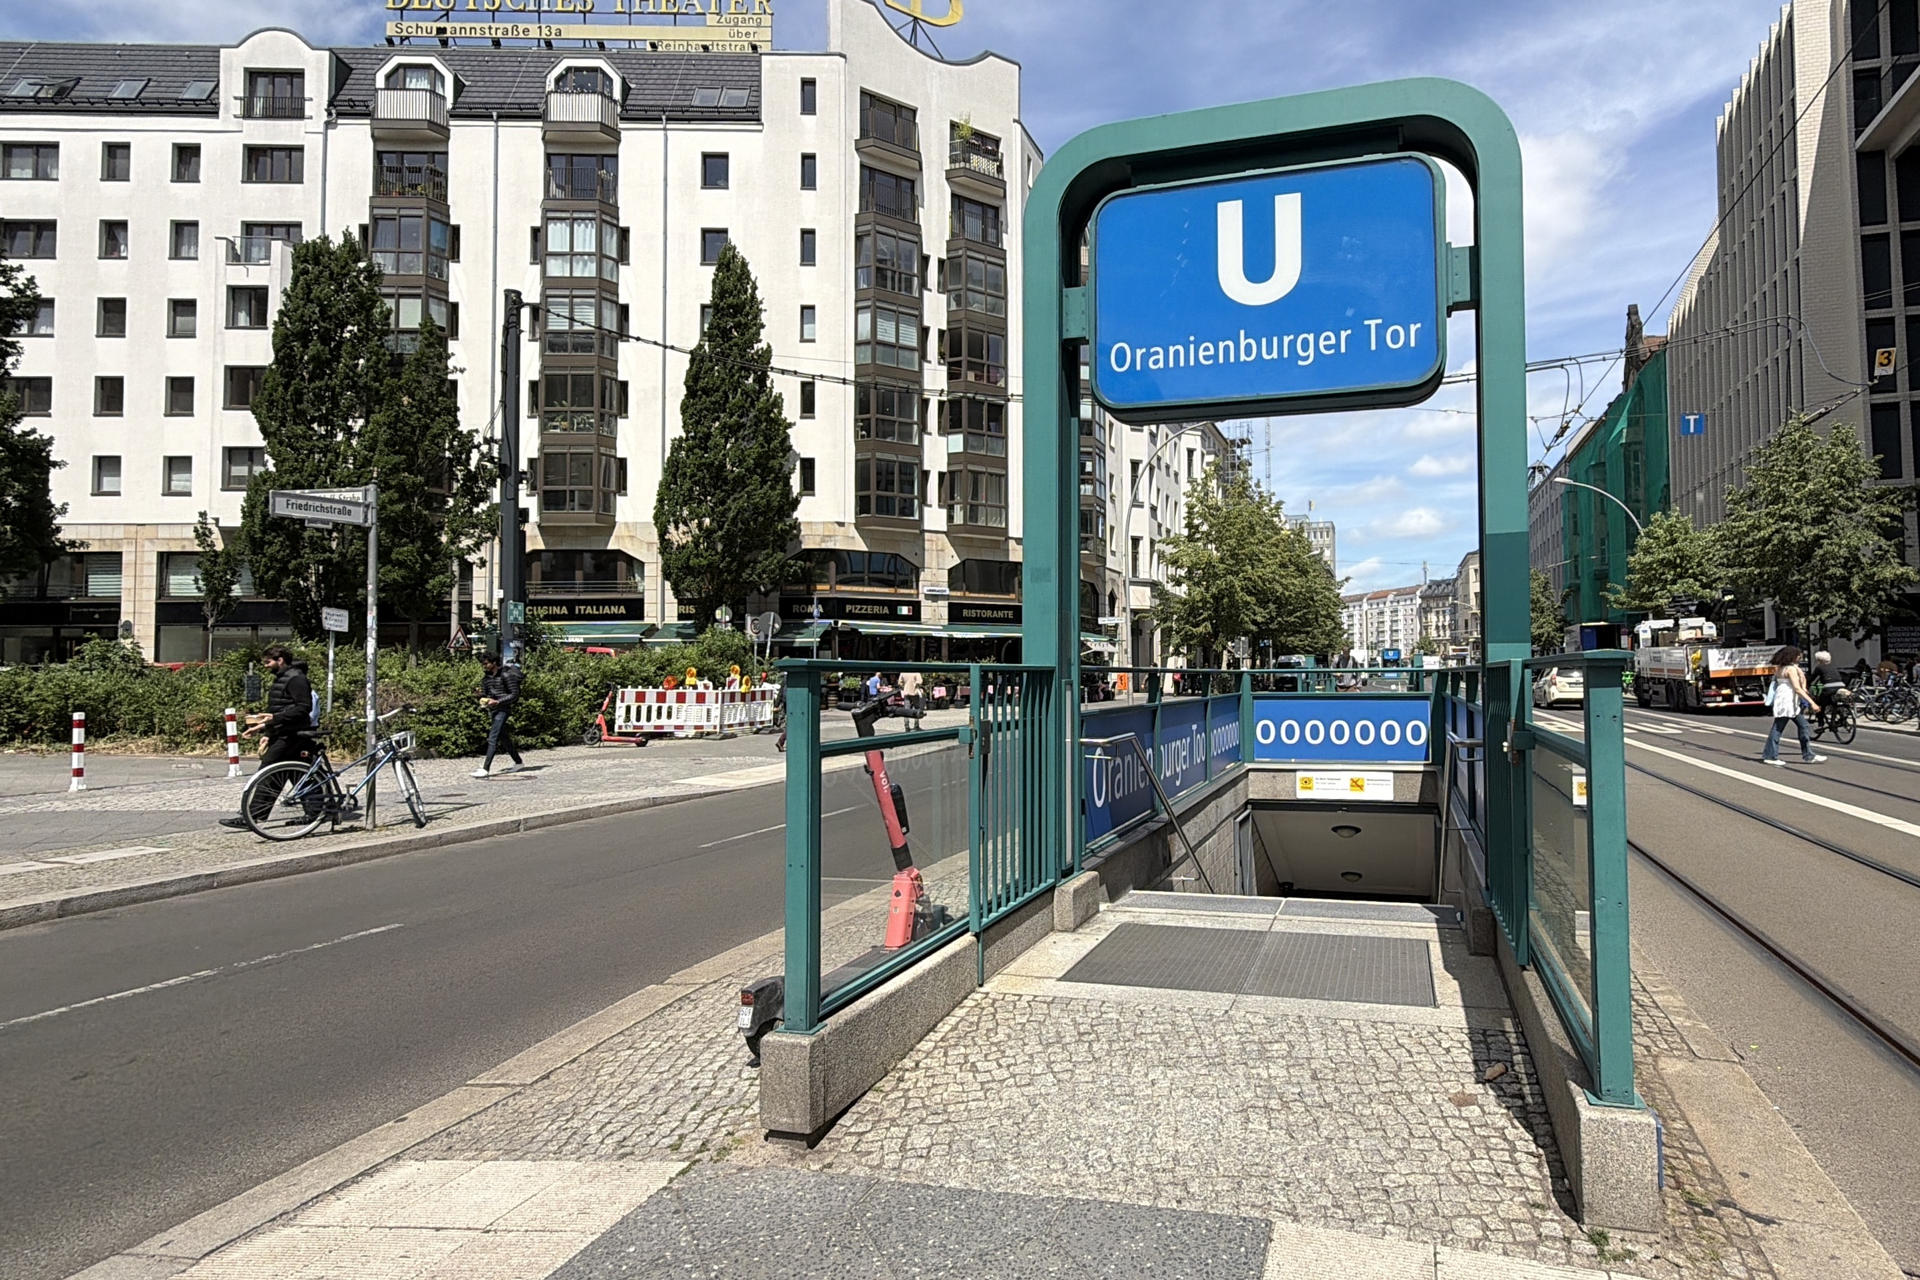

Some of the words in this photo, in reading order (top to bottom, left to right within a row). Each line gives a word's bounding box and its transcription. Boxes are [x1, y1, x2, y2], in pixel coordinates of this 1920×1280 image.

[716, 14, 762, 26] Zugang
[537, 25, 562, 37] 13a
[728, 29, 758, 39] über
[657, 40, 763, 51] Reinhadtstrae
[1217, 192, 1302, 306] U
[1110, 328, 1352, 373] Oranienburger
[1363, 318, 1422, 351] Tor
[1879, 350, 1892, 367] 3
[1685, 414, 1700, 433] T
[286, 498, 352, 517] Friedrichstraße
[575, 605, 626, 615] ITALIANA
[792, 604, 824, 613] ROMA
[845, 605, 890, 615] PIZZERIA
[962, 608, 1014, 619] RISTORANTE
